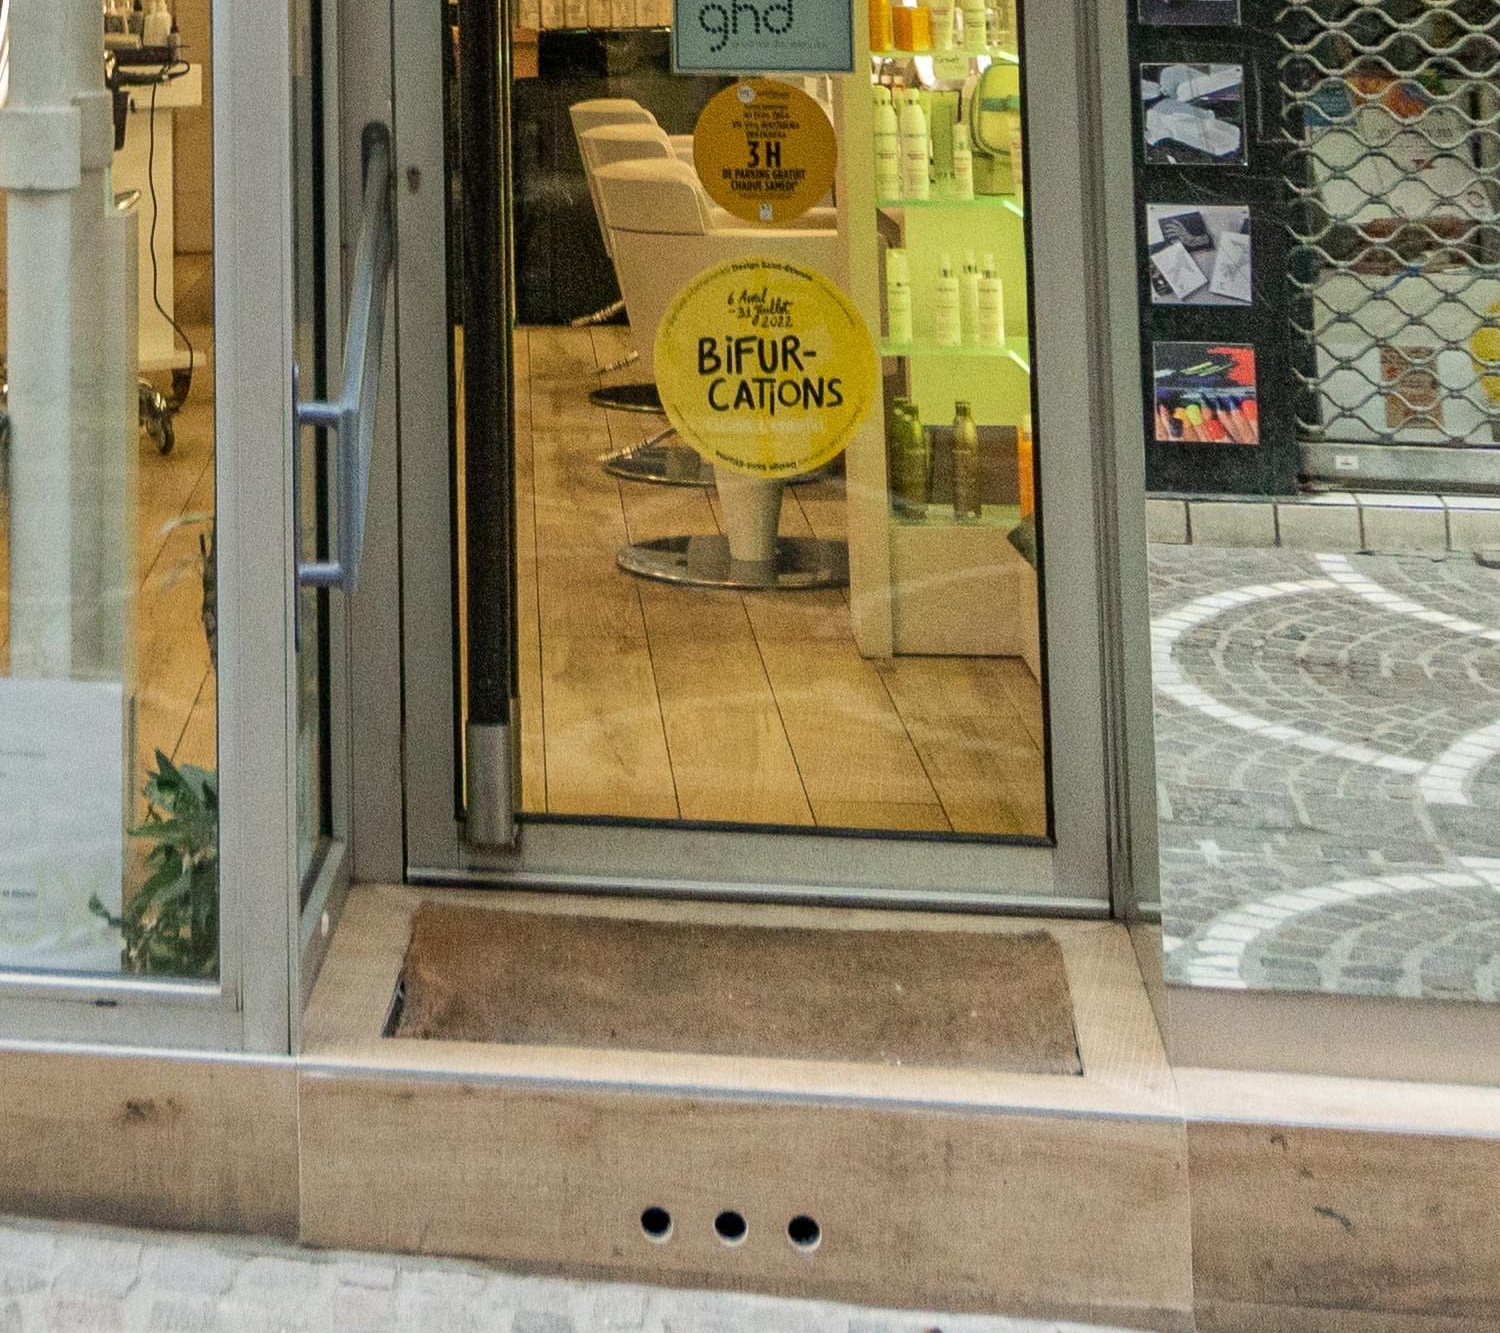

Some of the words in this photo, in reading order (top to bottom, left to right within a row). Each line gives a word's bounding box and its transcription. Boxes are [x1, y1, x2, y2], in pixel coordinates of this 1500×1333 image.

[747, 140, 760, 168] 3
[765, 140, 781, 168] H
[760, 315, 793, 328] 2022
